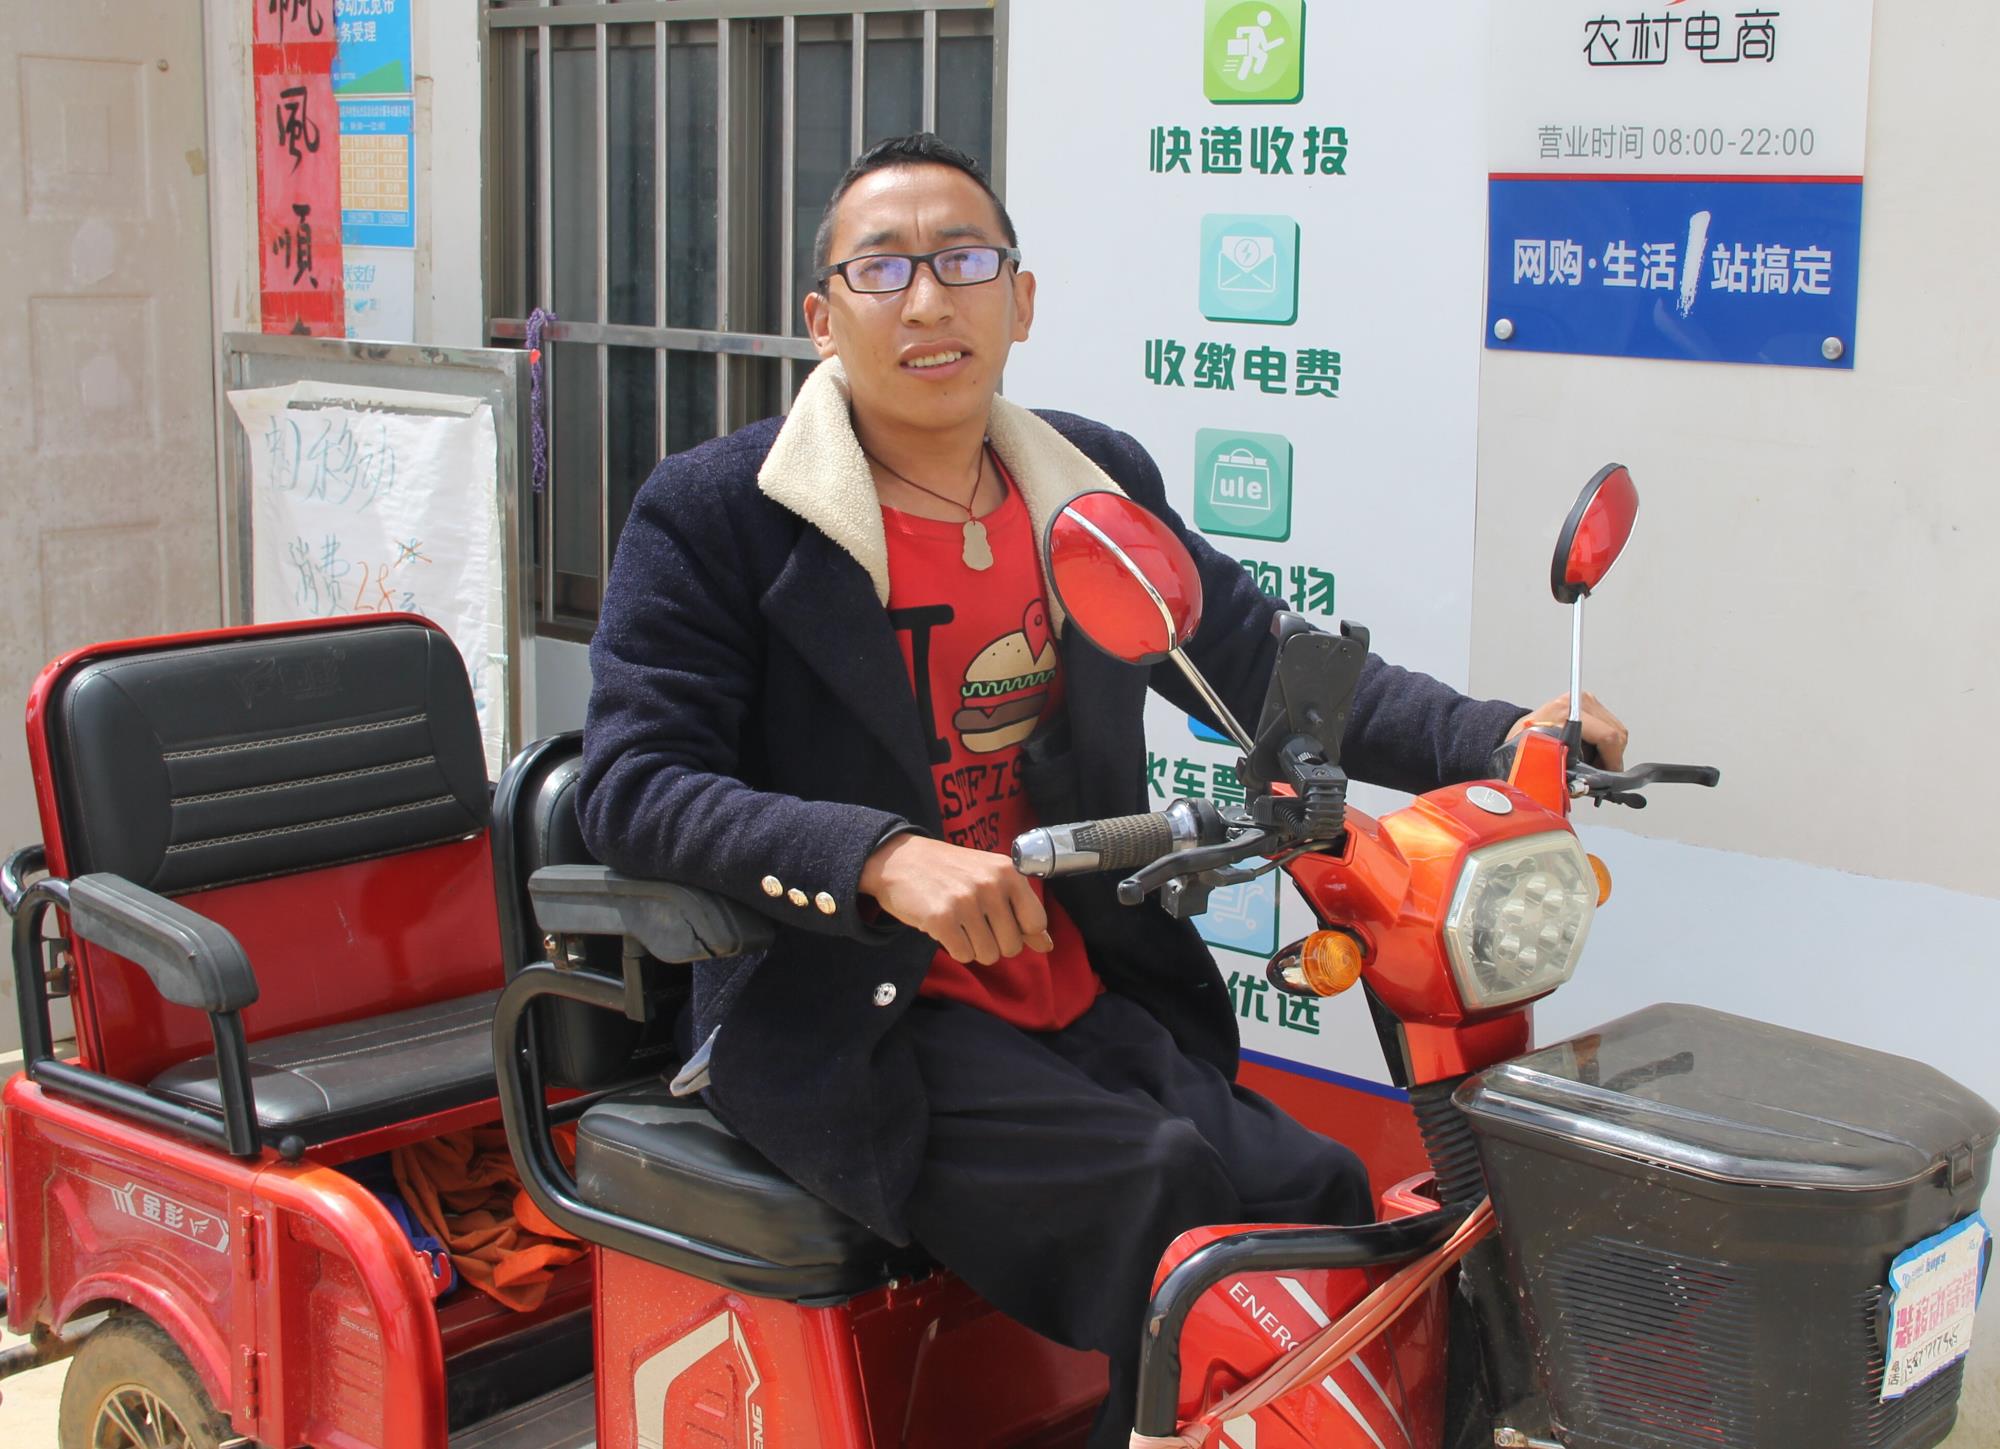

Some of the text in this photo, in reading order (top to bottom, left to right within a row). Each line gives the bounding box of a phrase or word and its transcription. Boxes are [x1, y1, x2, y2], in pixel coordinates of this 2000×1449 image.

[338, 21, 376, 42] 务受理
[1583, 9, 1780, 66] 农村电商
[1149, 126, 1348, 175] 快递收投
[1538, 125, 1815, 159] 营业时间 08:00-22:00
[1145, 339, 1341, 398] 收缴电费
[1220, 476, 1262, 499] ule
[143, 1194, 183, 1229] 金彭
